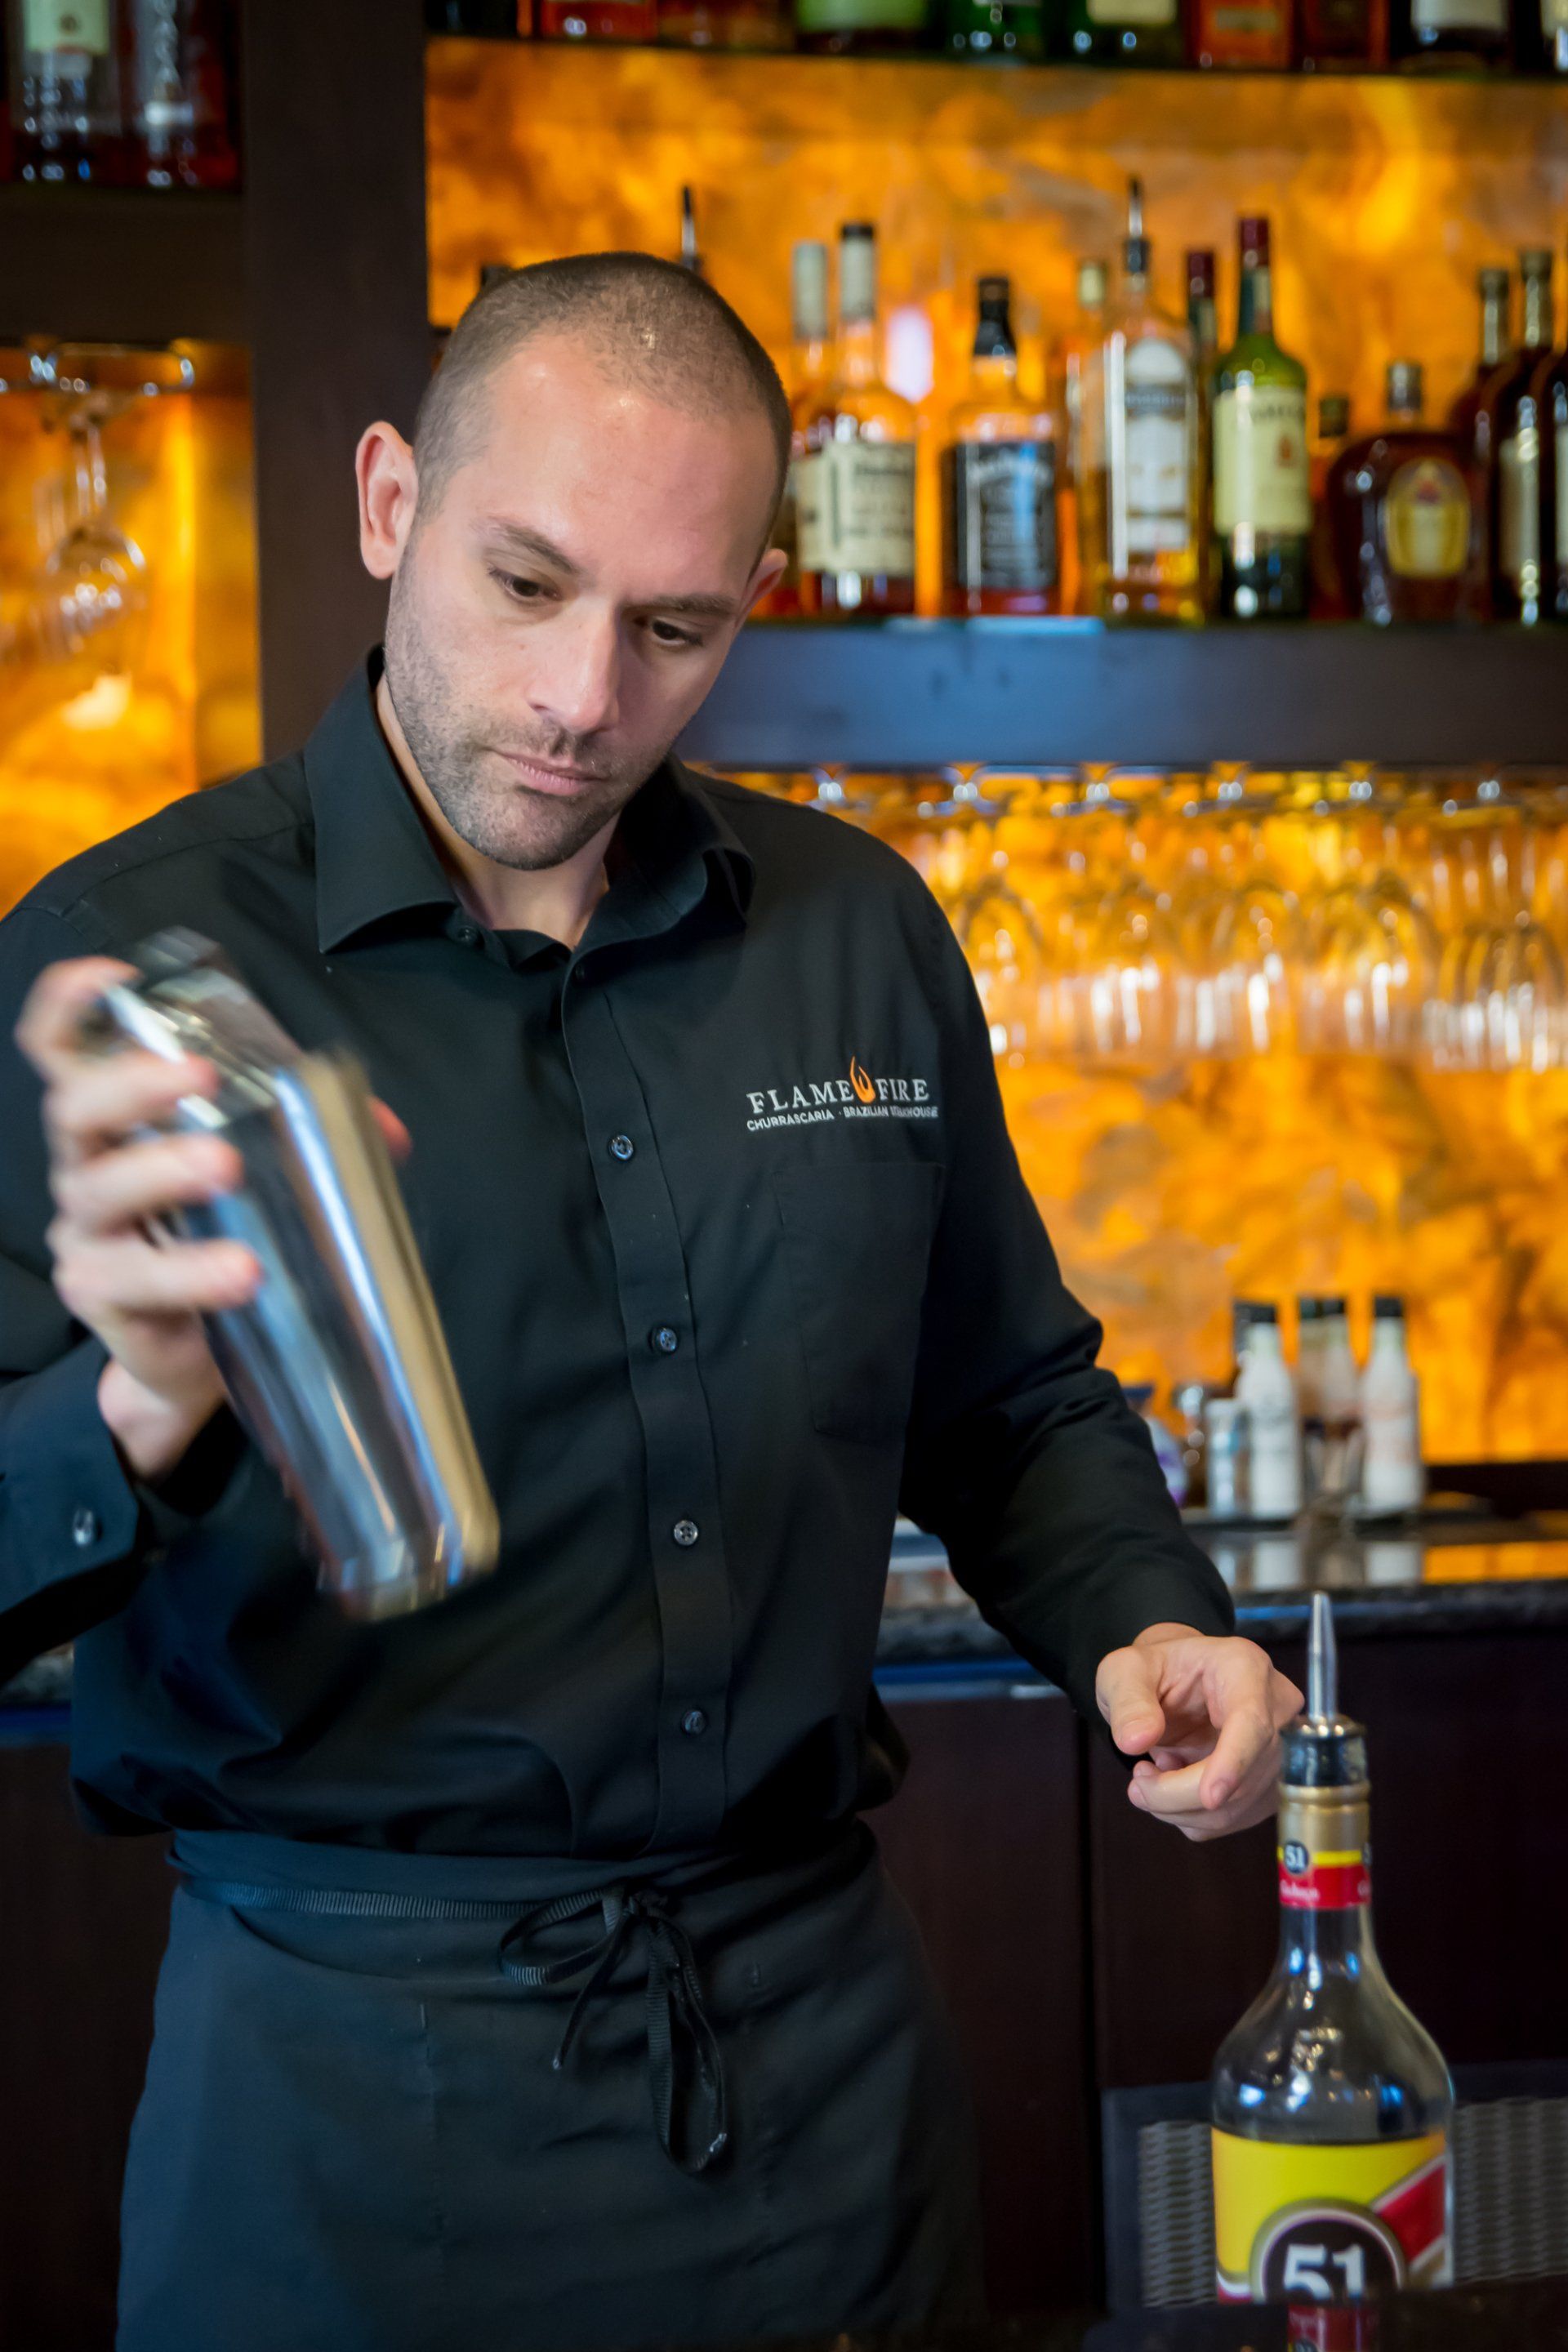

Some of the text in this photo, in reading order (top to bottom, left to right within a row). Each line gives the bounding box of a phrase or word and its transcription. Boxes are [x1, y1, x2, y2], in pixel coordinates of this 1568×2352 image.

[746, 1078, 929, 1114] FLAME FIRE
[746, 1109, 835, 1131] CHURRASCARIA
[843, 1106, 889, 1118] BRAZILIAN
[1285, 1844, 1305, 1869] 51
[1283, 2243, 1364, 2300] 51
